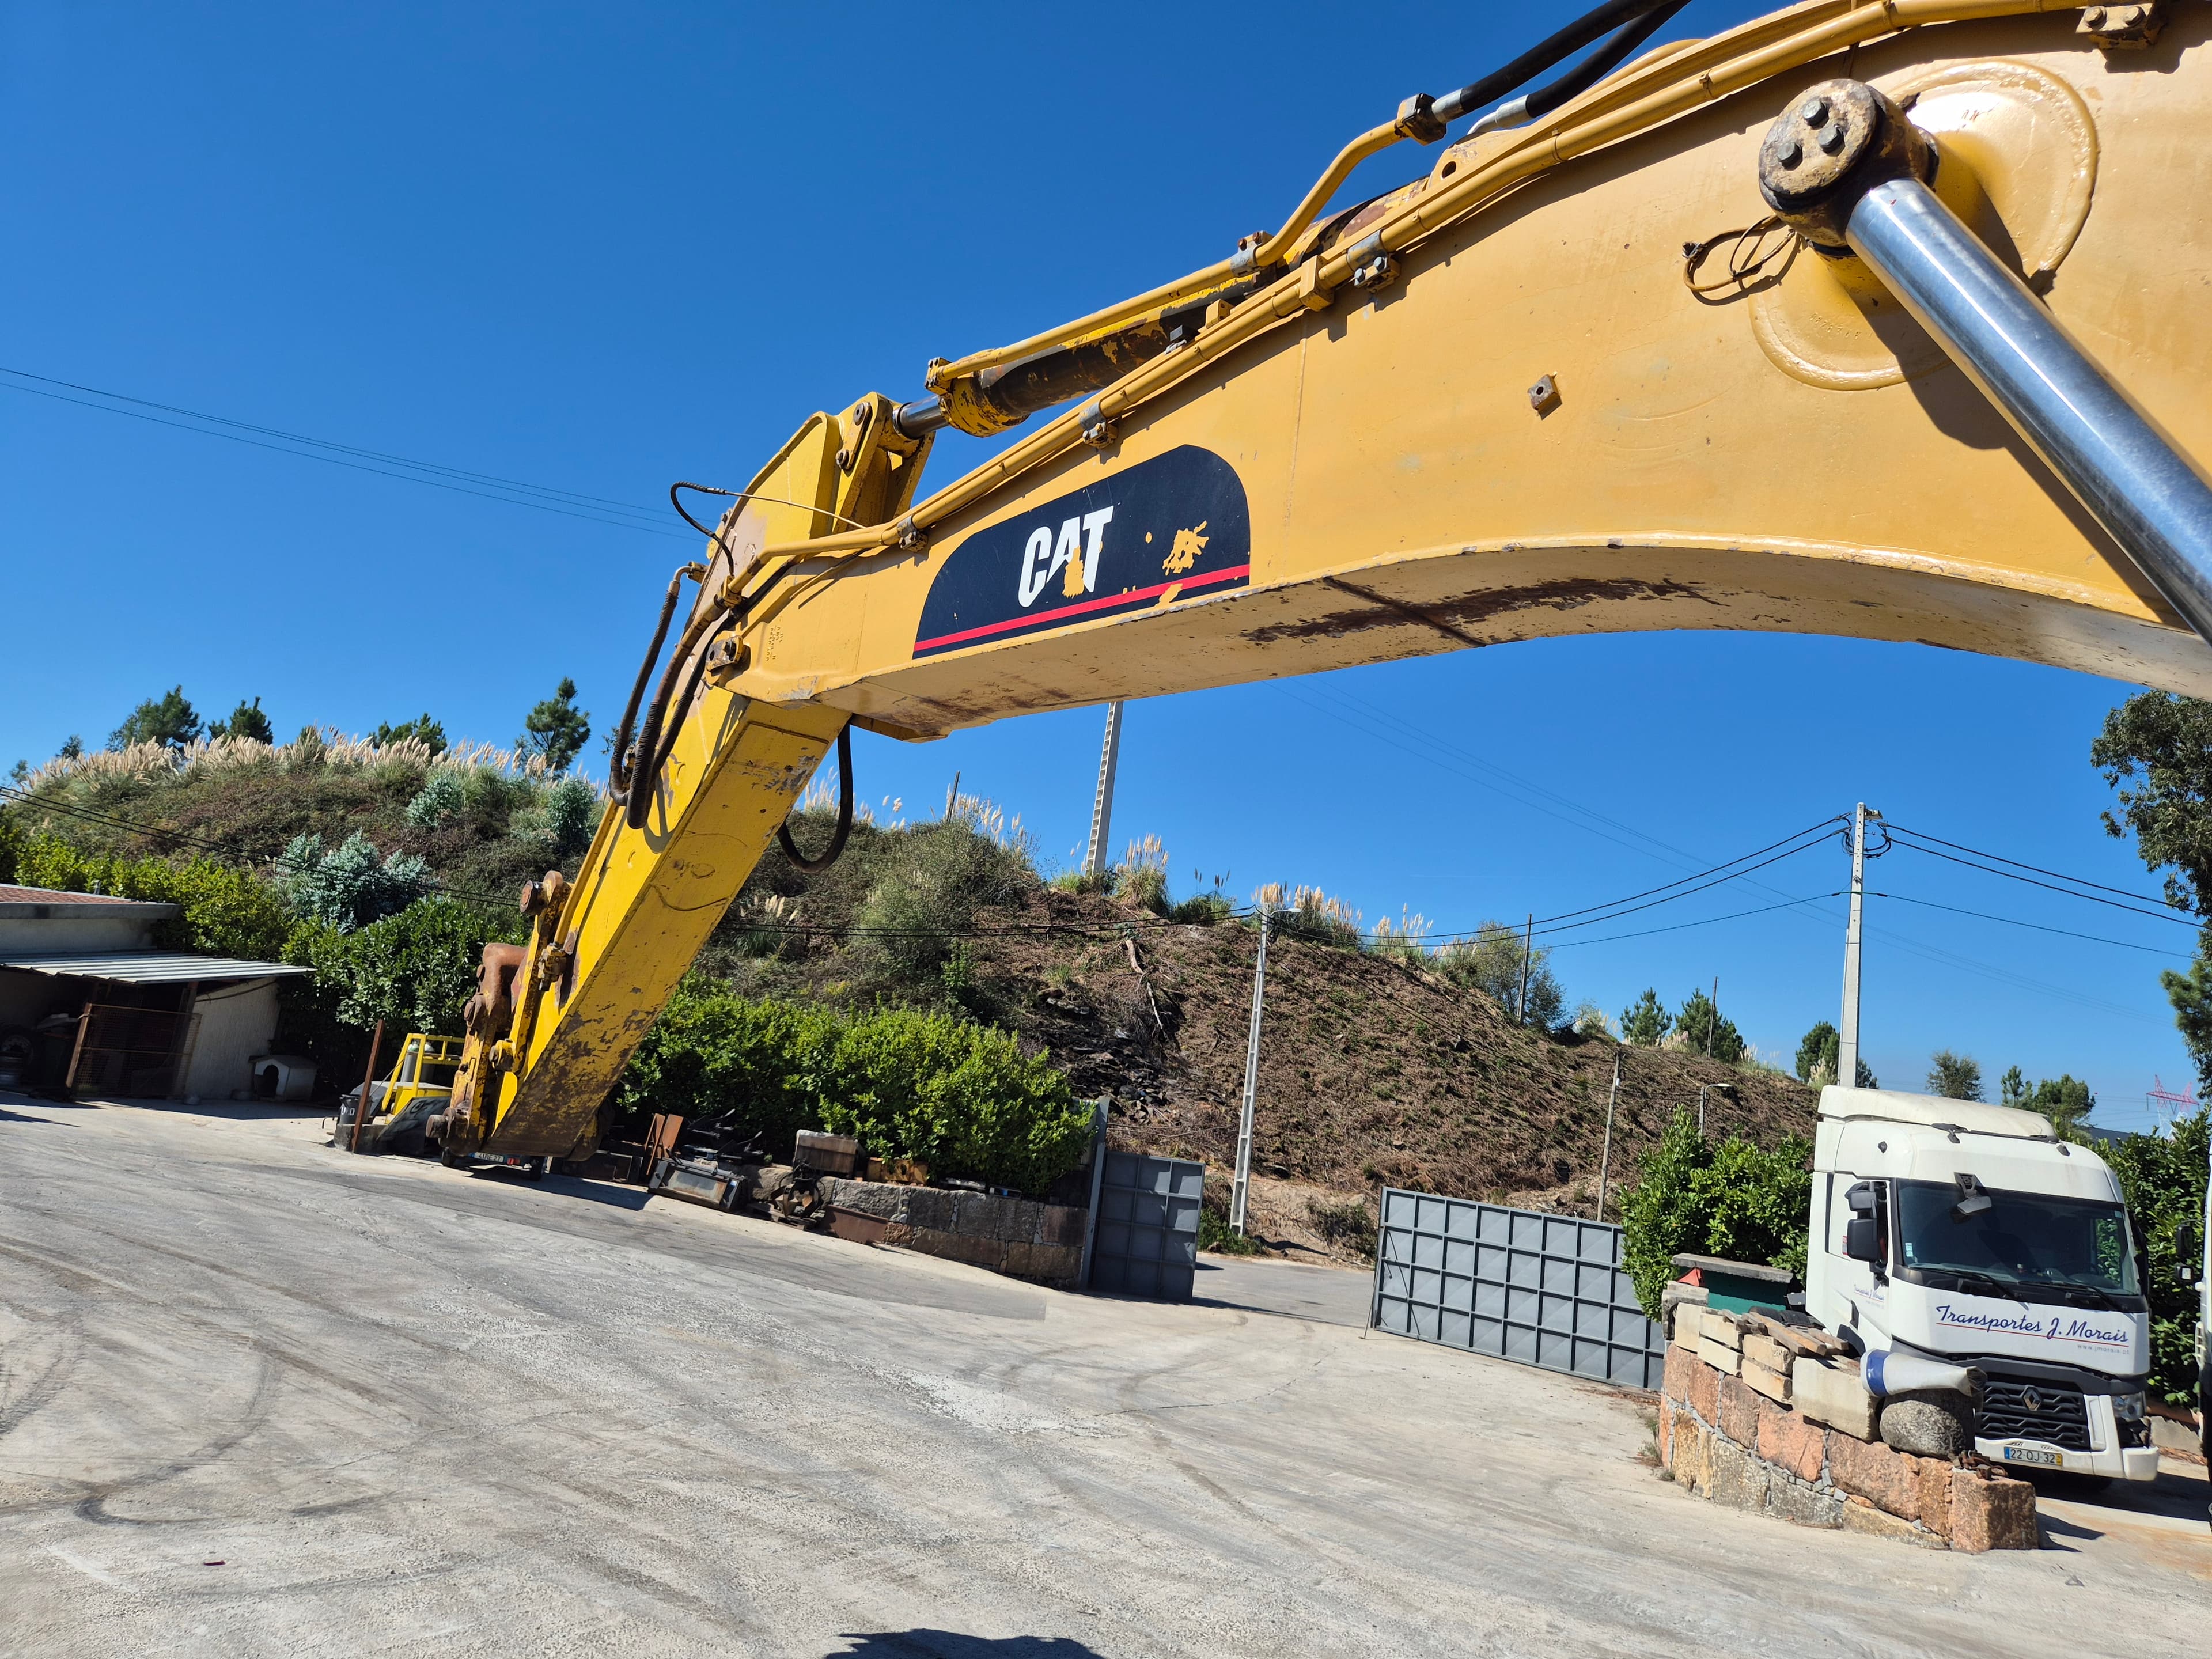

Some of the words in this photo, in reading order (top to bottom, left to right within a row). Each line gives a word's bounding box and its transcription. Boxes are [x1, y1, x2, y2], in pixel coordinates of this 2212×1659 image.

[1018, 505, 1113, 607] CAT
[1936, 1305, 2043, 1332] Transportes
[2046, 1317, 2062, 1340] J.
[2066, 1320, 2128, 1342] Morais
[2077, 1344, 2129, 1355] www.jmorais.pt
[2010, 1449, 2055, 1463] 22-QJ-32
